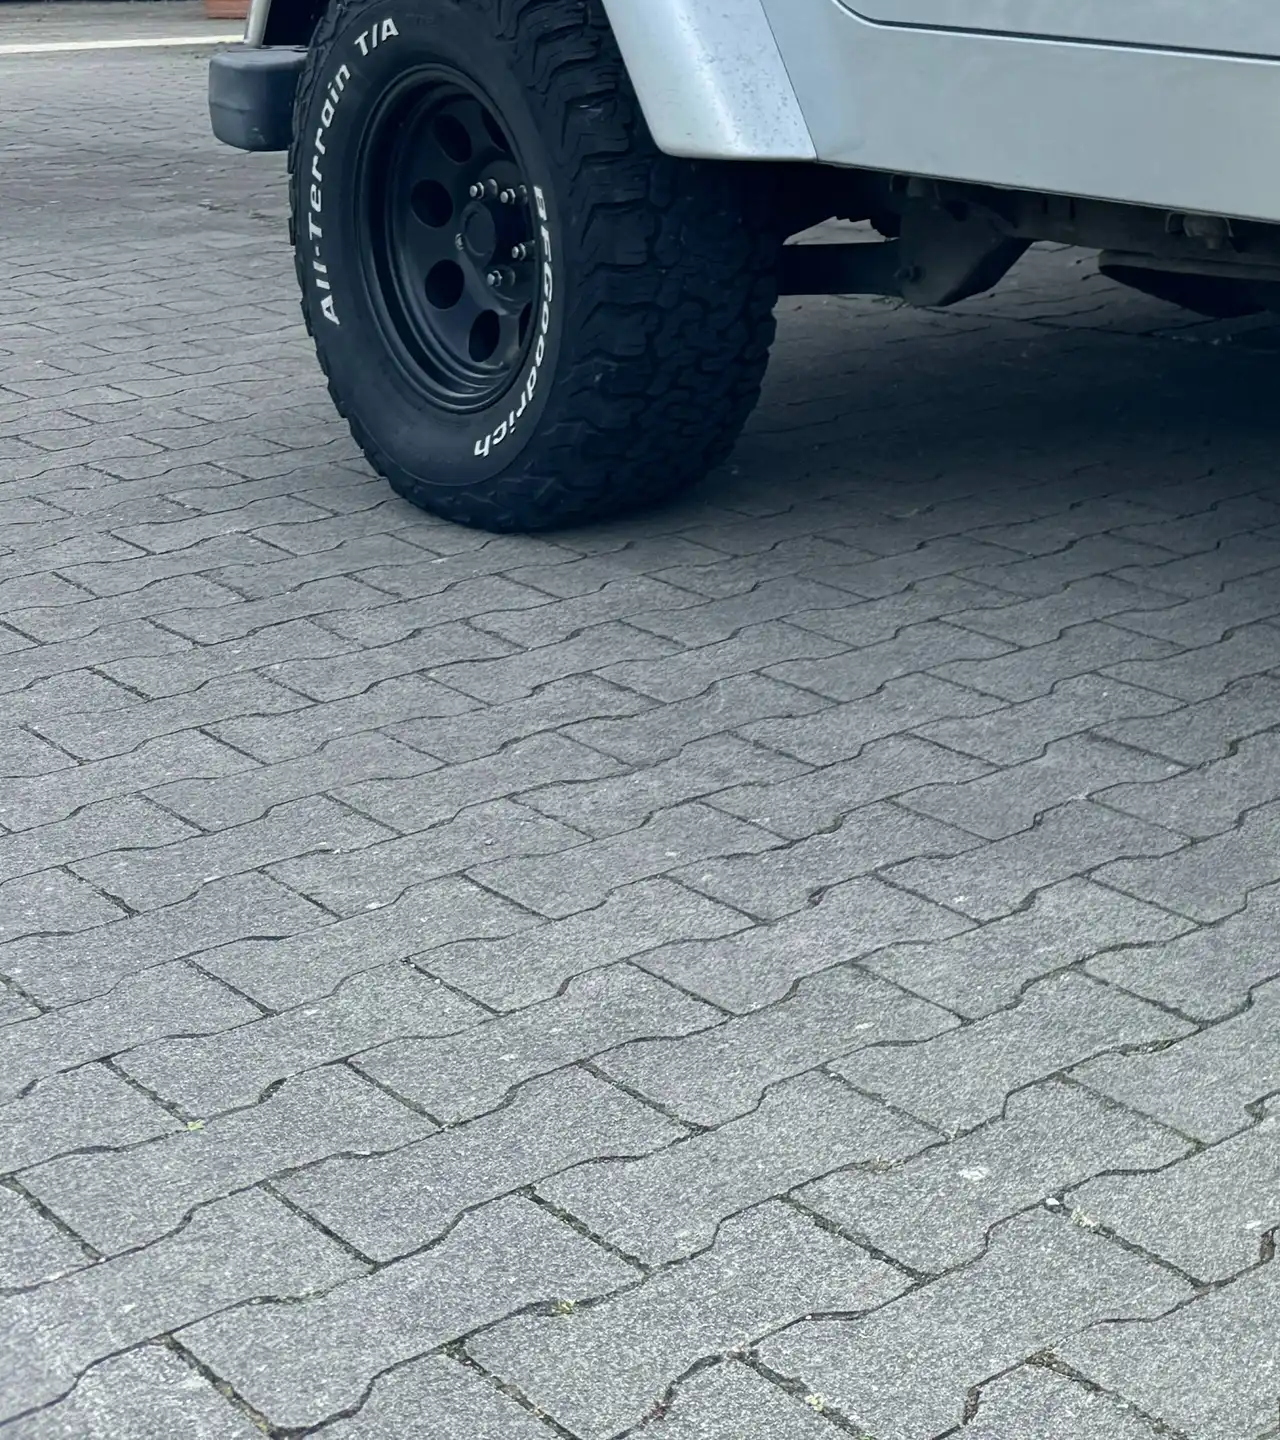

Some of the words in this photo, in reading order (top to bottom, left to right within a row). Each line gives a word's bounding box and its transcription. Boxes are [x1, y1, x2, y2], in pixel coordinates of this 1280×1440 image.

[305, 63, 352, 327] All-Terrain
[354, 17, 400, 57] T/A
[474, 185, 556, 458] BFGoodrich
